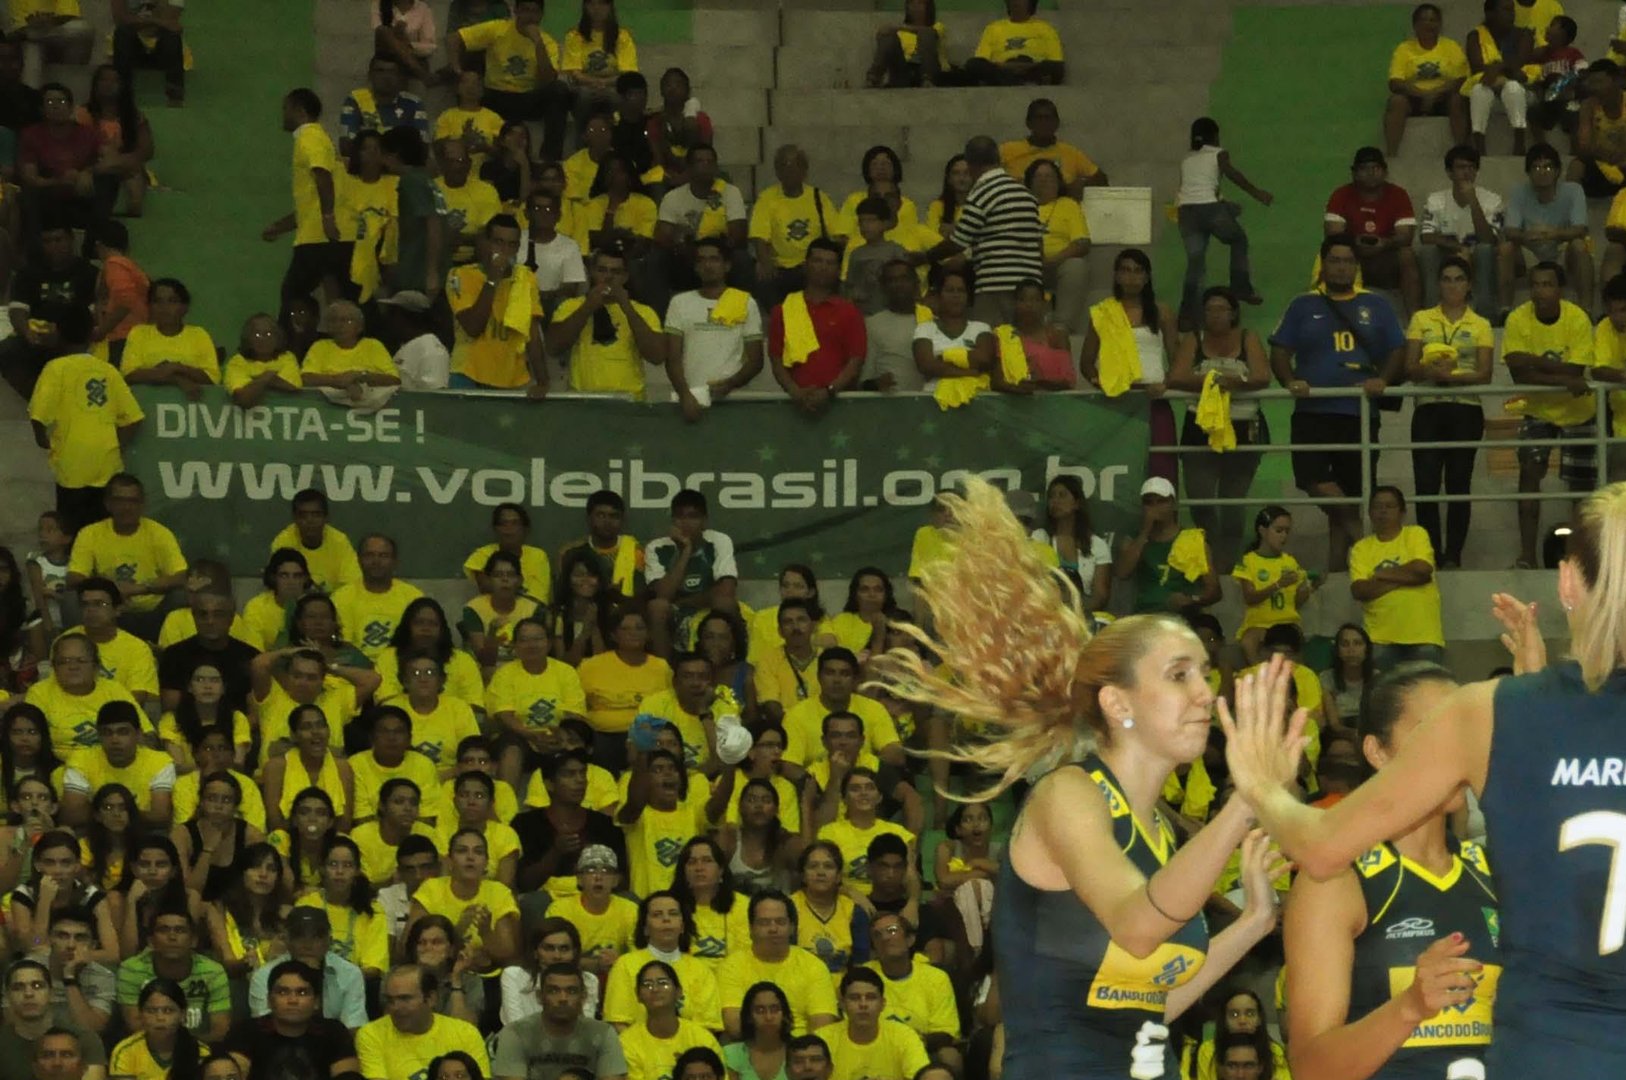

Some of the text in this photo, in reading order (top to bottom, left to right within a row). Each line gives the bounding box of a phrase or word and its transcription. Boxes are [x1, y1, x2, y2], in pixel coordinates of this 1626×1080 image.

[1333, 331, 1355, 352] 10
[157, 402, 401, 443] DIVIRTA-SE
[1411, 1023, 1451, 1039] ANCO
